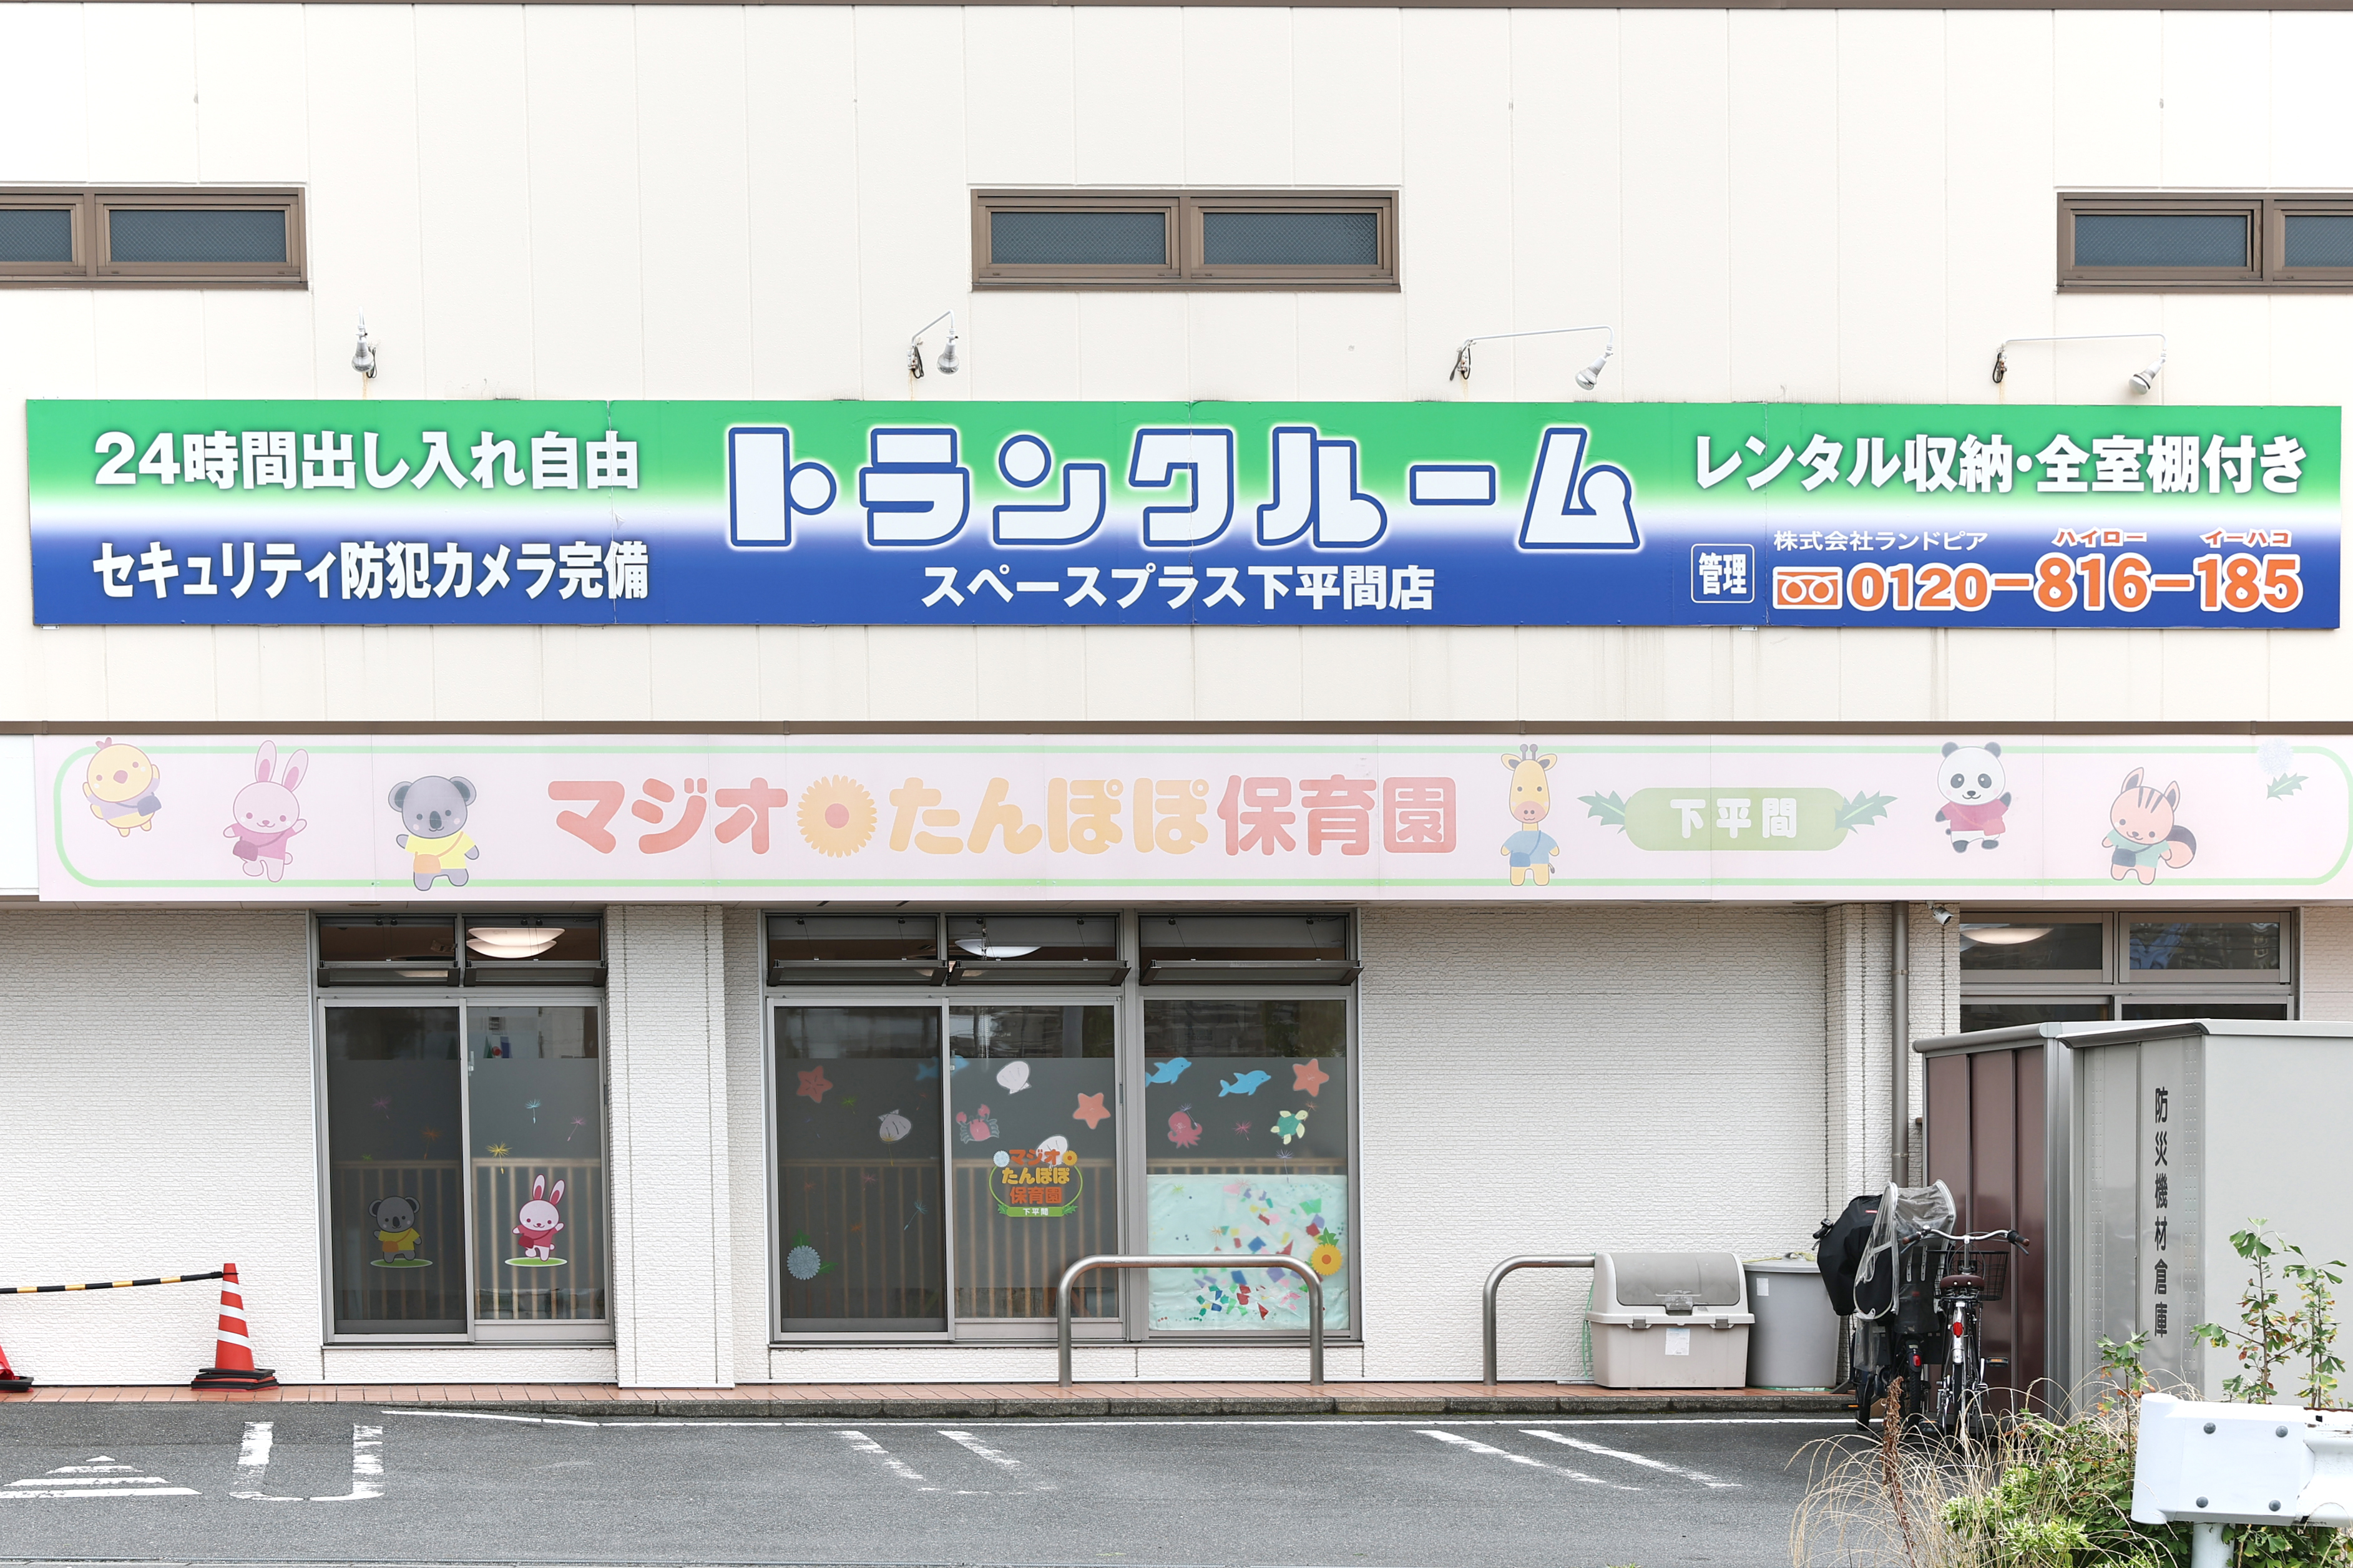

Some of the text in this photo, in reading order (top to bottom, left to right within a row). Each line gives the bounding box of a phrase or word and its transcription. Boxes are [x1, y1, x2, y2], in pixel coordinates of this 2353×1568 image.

[94, 430, 639, 490] 24時間出し入れ自由
[1696, 434, 2307, 494] レンタル収納・全室棚付き
[727, 427, 1640, 549] トランクルーム
[1773, 530, 1989, 552] 株式会社ランドピア
[2053, 528, 2146, 547] ハイロー
[2201, 528, 2291, 547] イーハコ
[92, 540, 649, 600] セキュリティ防犯カメラ完備
[921, 562, 1435, 611] スペースプラス下平間店
[1698, 552, 1747, 597] 管理
[1849, 553, 2302, 611] 0120-816-185
[547, 774, 1457, 856] マジオ たんぽぽ保育園
[1669, 797, 1798, 839] 下平間
[1002, 1167, 1070, 1184] たんぽぽ
[1009, 1149, 1060, 1166] マジオ
[1009, 1186, 1062, 1204] 保育園
[1023, 1207, 1049, 1215] 下平間
[2154, 1086, 2169, 1338] 防災機材倉庫
